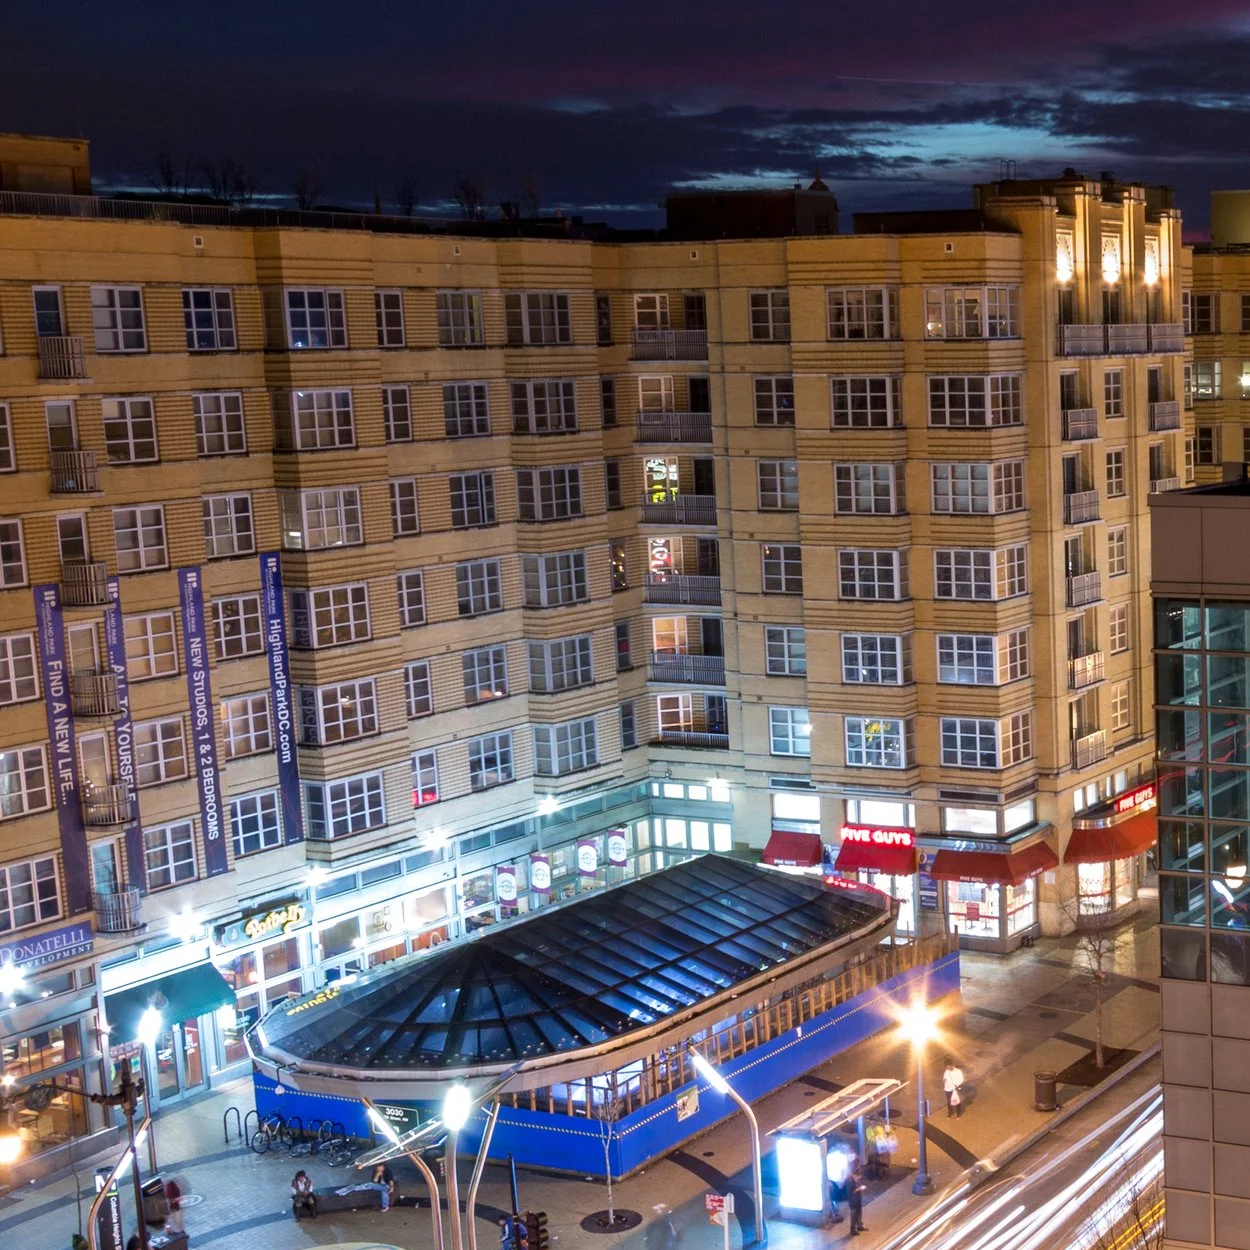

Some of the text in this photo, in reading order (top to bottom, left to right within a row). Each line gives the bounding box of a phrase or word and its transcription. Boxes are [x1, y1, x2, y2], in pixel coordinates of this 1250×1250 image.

[269, 619, 292, 763] HighlandParkDC.com
[48, 660, 74, 805] FIND A NEW LIFE...
[190, 638, 220, 840] NEW STUDIOS, 1 & 2 BEDROOMS
[1120, 787, 1153, 812] FIVE GUYS
[840, 827, 912, 846] FIVE GUYS
[245, 902, 306, 938] Potbelly
[0, 929, 84, 965] DONATELLI
[18, 943, 92, 970] VELOPMENT
[385, 1107, 404, 1117] 3030
[94, 1173, 116, 1193] M
[110, 1197, 120, 1223] Columbia
